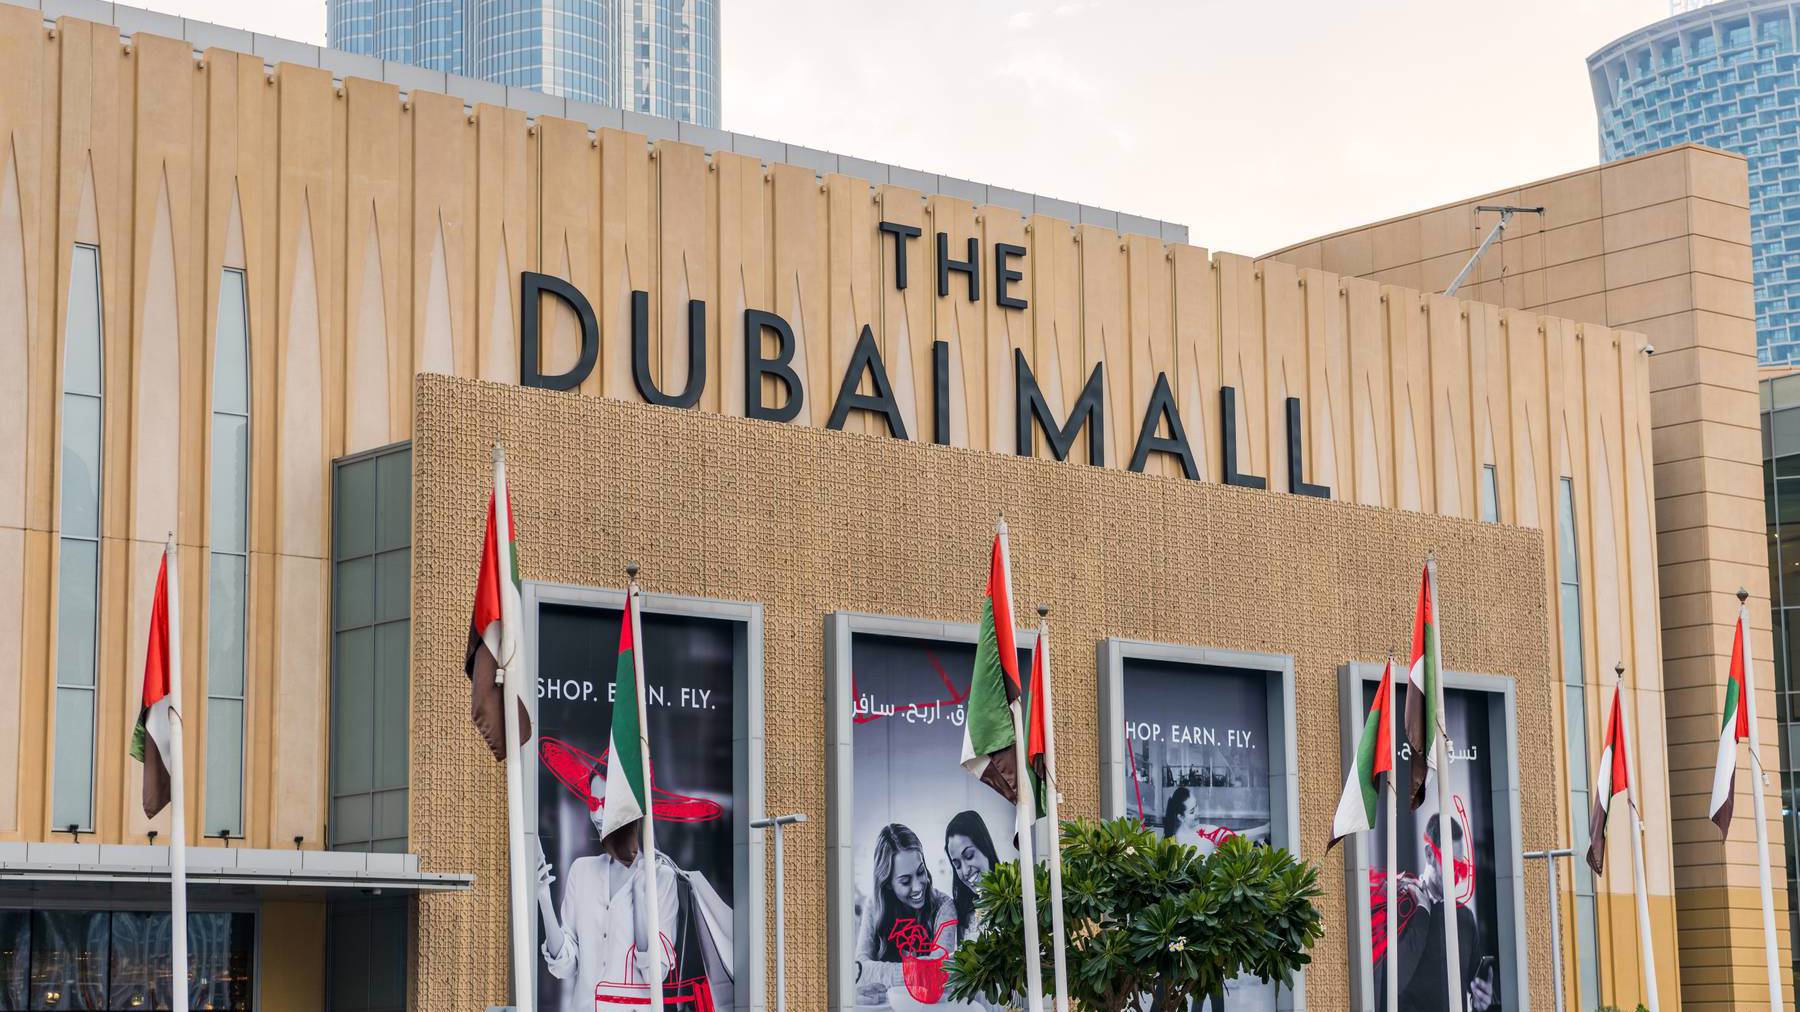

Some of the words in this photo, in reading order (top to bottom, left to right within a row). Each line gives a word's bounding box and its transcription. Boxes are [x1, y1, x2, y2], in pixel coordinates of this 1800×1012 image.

[879, 221, 1028, 310] THE
[520, 271, 950, 446] DUBAI
[1016, 347, 1331, 498] MALL
[537, 677, 598, 702] SHOP.
[608, 682, 671, 707] EN.
[681, 687, 716, 710] FLY.
[901, 699, 940, 725] اربح.
[1125, 721, 1164, 742] HOP.
[1171, 725, 1221, 746] EARN.
[1228, 730, 1256, 749] FLY.
